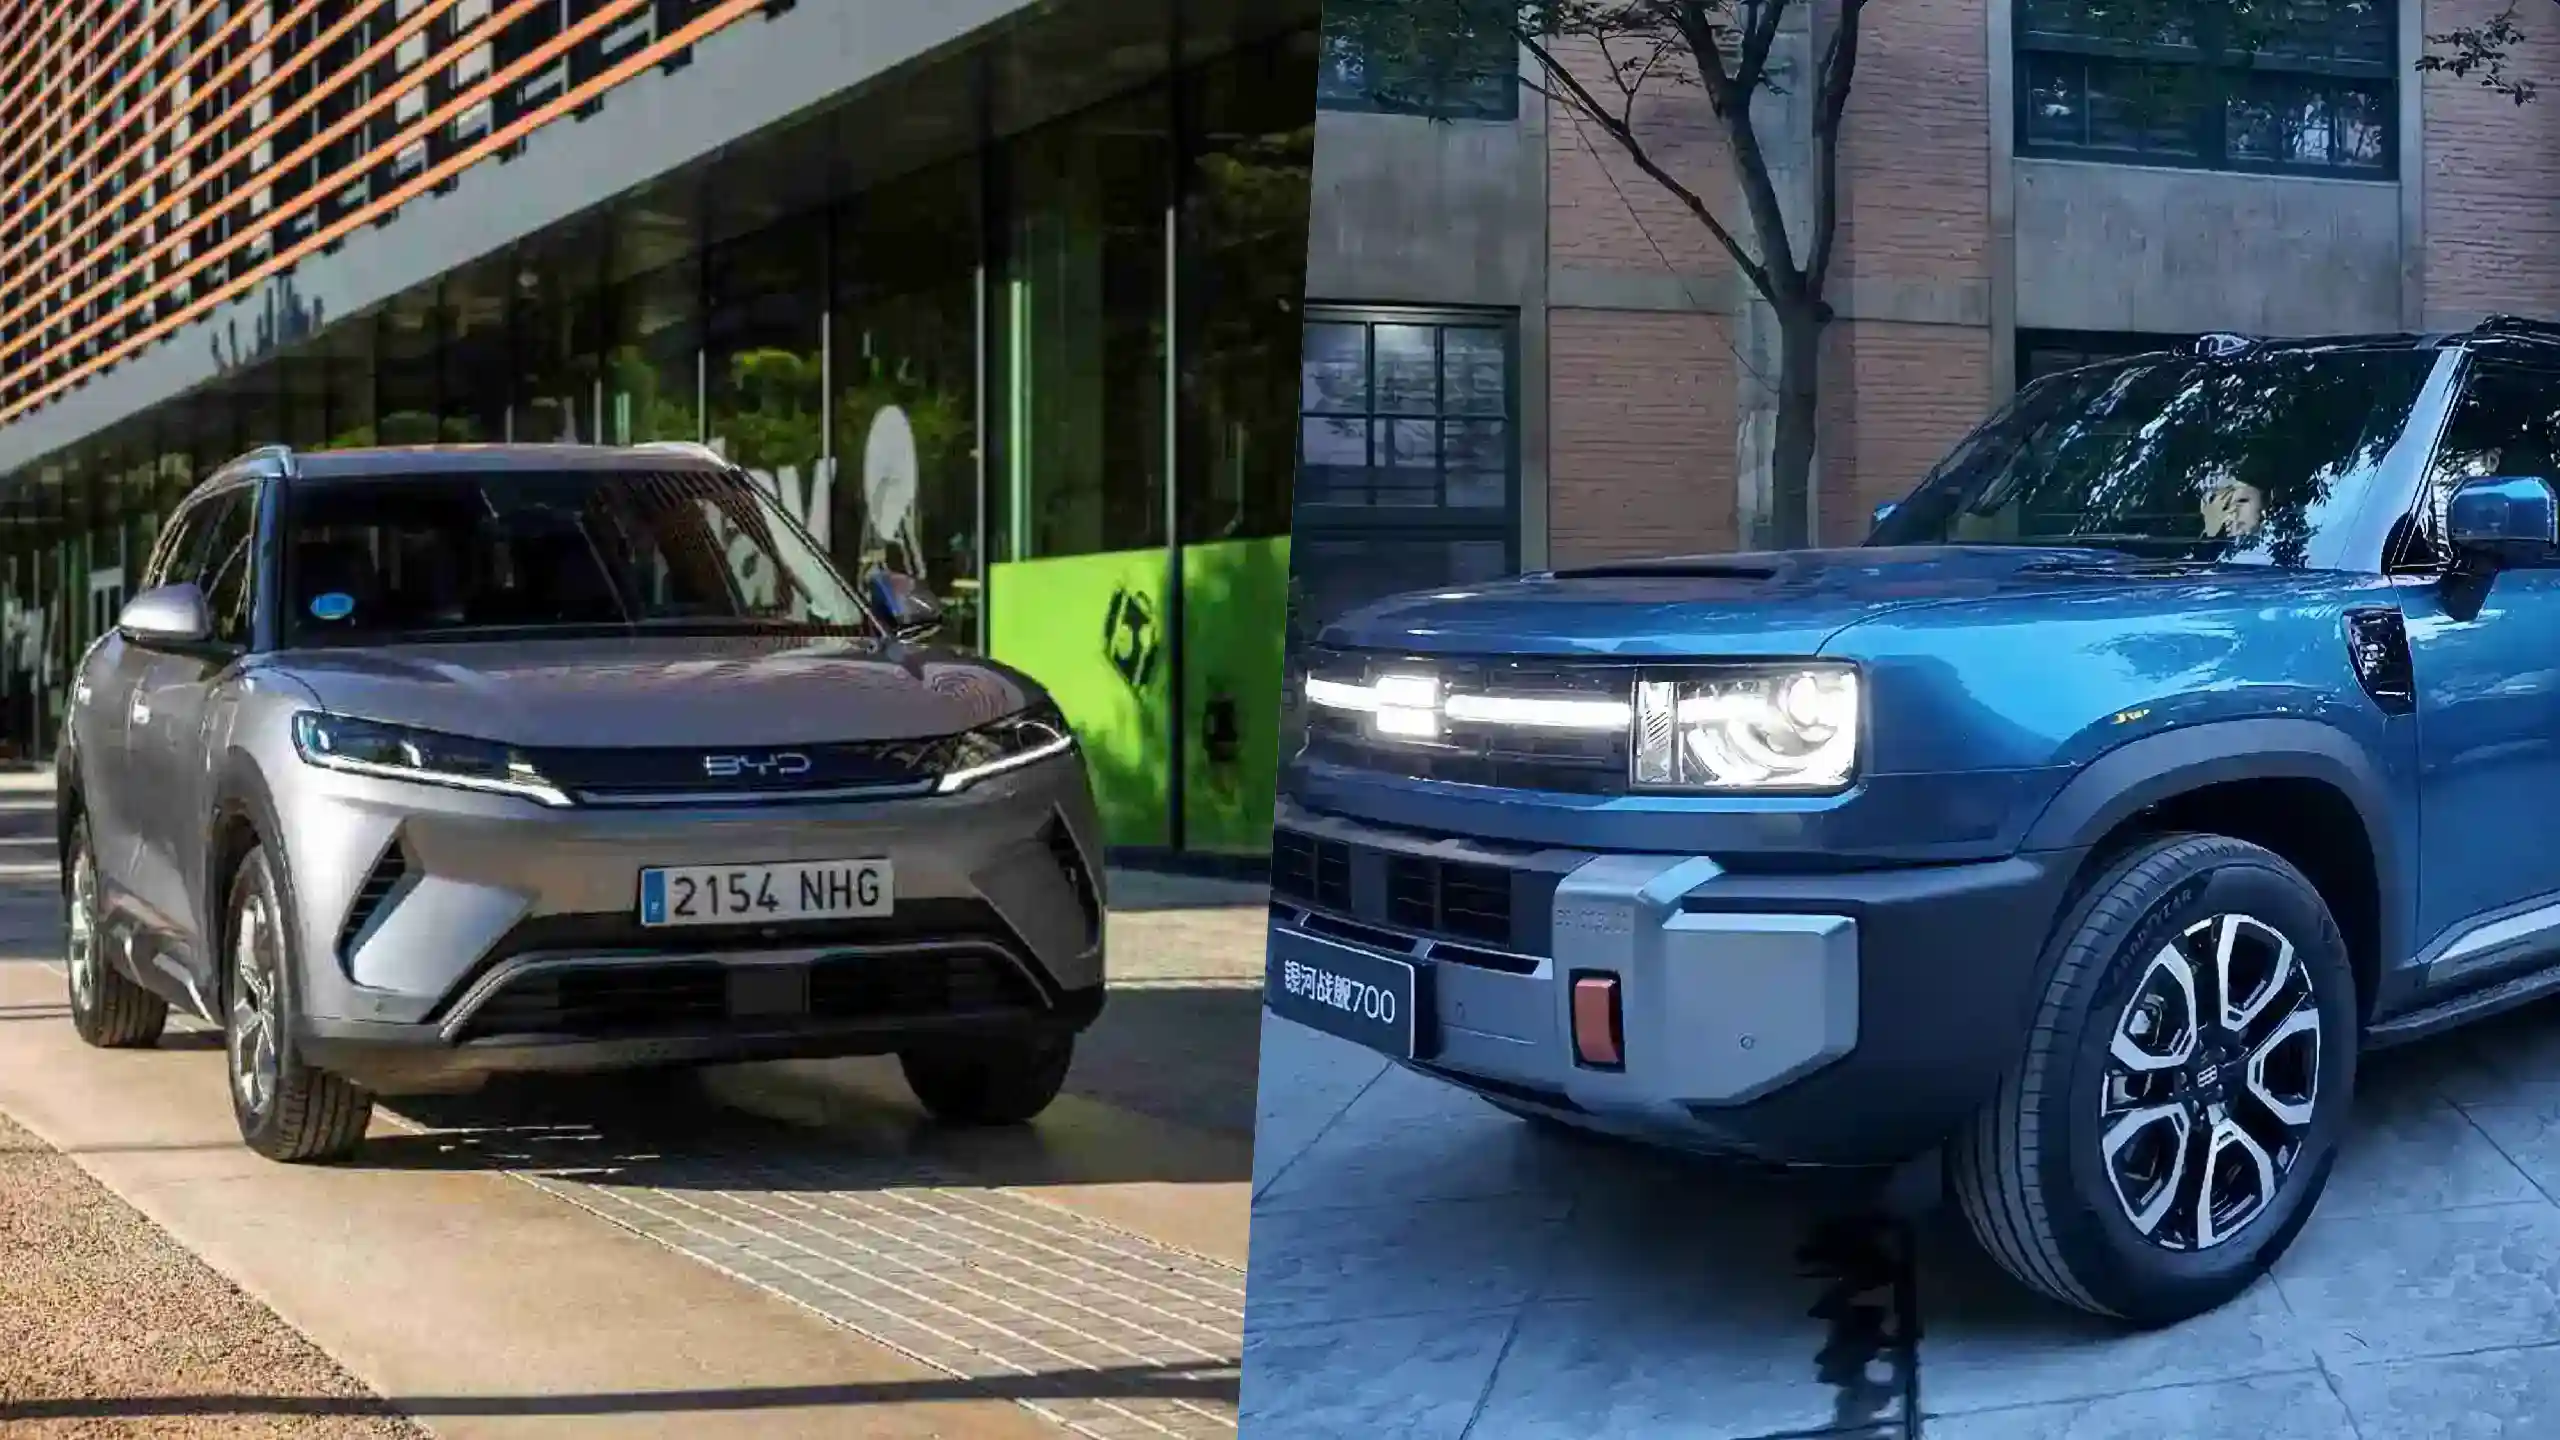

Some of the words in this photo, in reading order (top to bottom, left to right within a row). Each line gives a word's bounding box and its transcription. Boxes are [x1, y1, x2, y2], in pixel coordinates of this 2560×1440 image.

[703, 752, 812, 776] BYD
[673, 872, 780, 917] 2154
[799, 868, 880, 910] NHG
